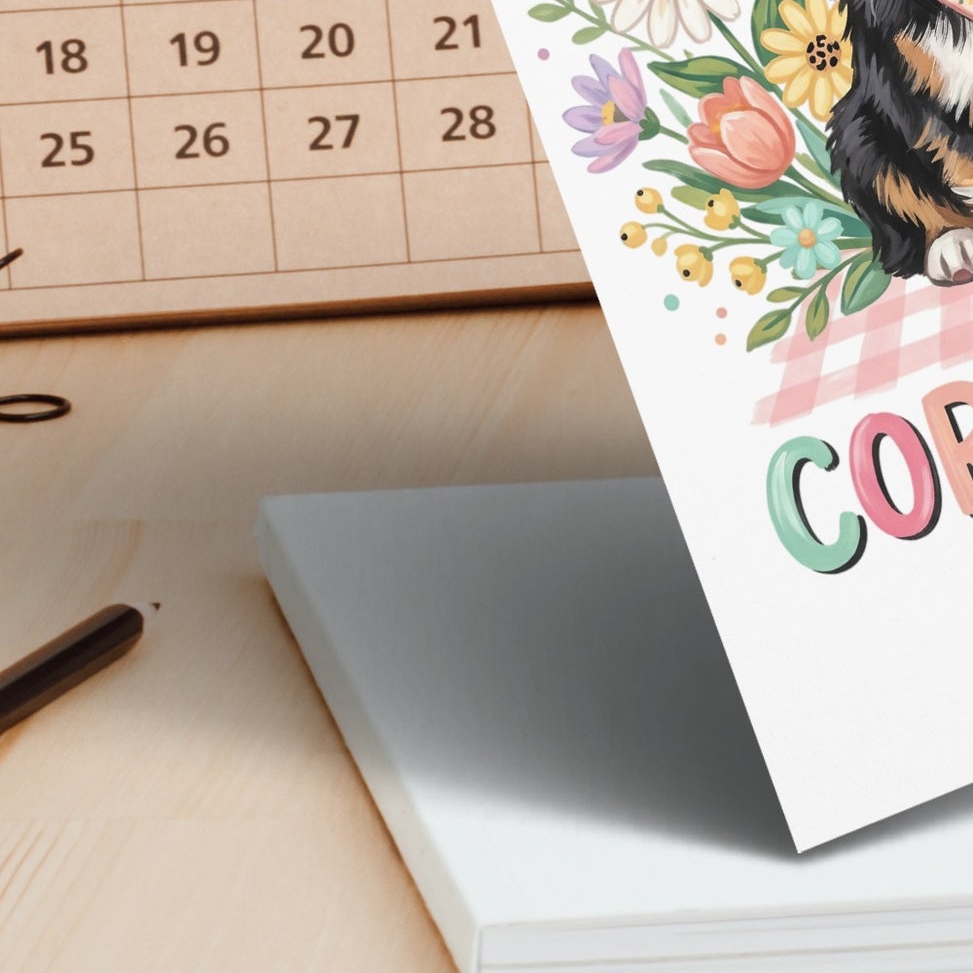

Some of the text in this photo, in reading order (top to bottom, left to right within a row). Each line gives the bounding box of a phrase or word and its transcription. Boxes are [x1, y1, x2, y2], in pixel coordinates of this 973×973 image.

[35, 14, 482, 75] 18 19 20 21
[40, 104, 497, 168] 25 26 27 28
